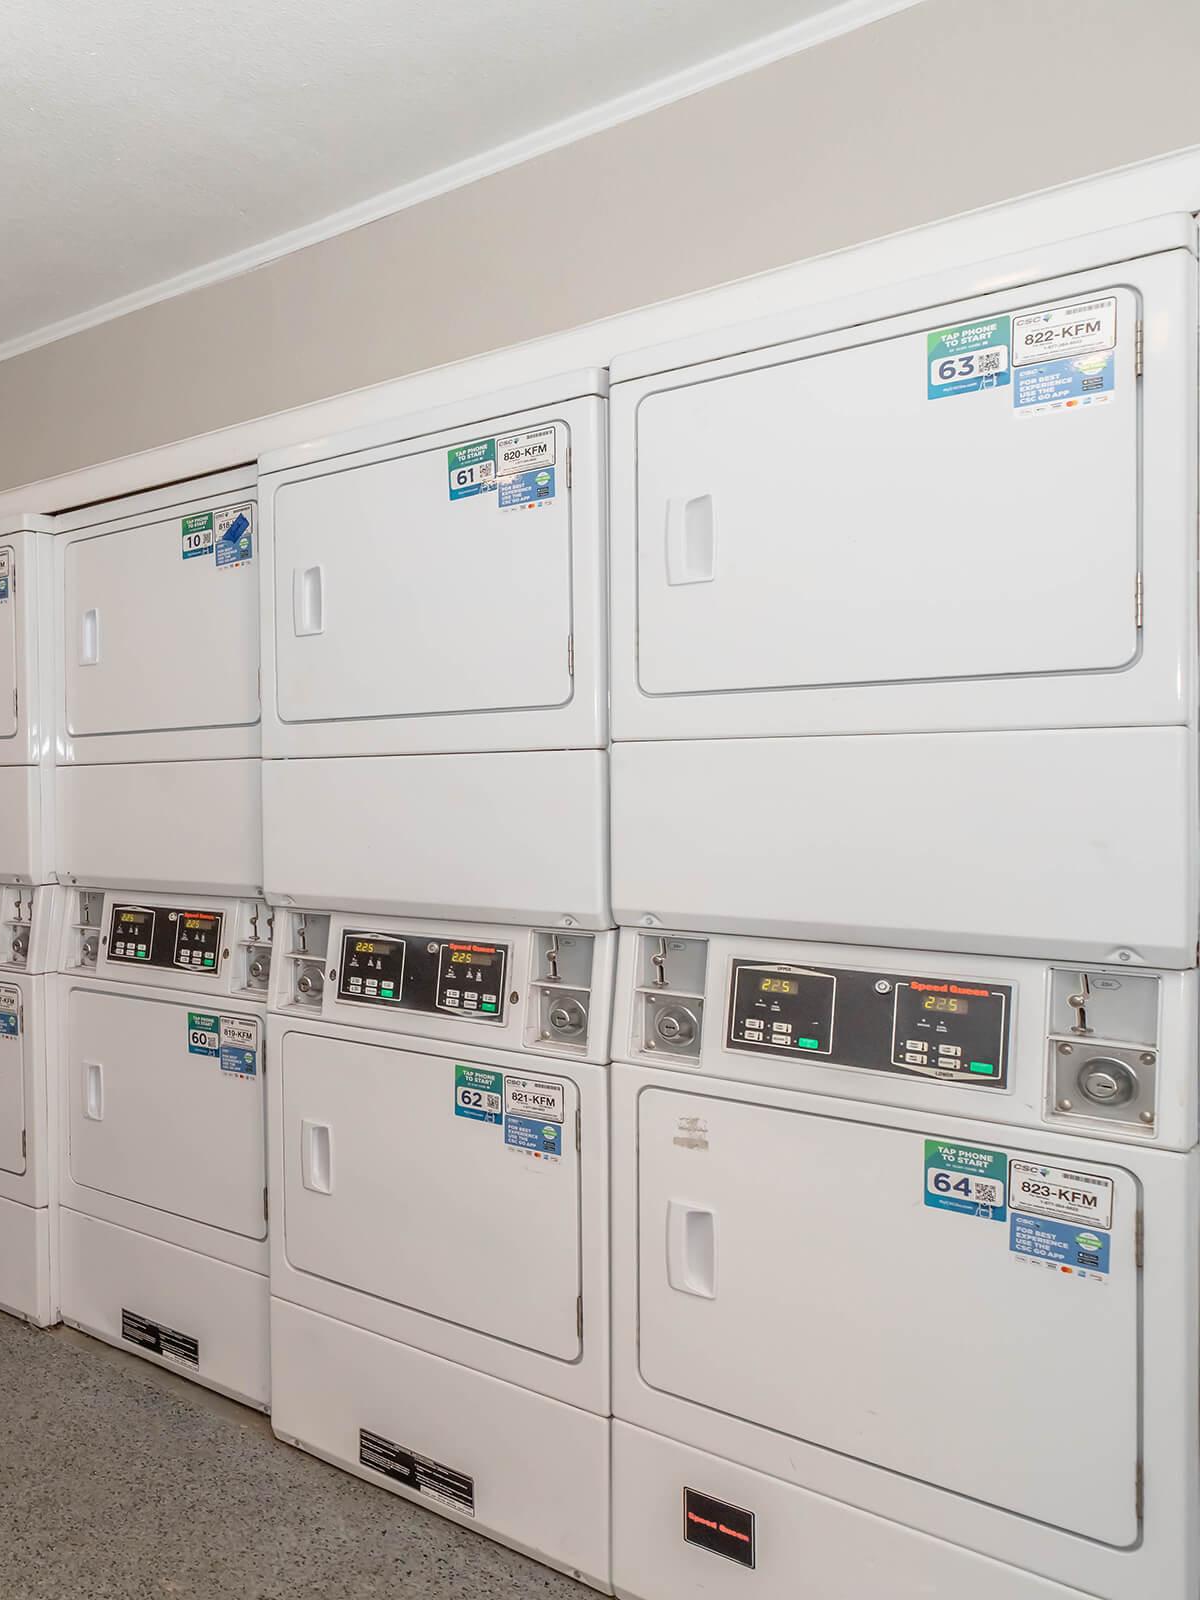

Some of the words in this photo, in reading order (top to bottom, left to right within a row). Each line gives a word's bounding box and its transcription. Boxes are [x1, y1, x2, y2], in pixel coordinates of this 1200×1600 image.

[1016, 316, 1041, 327] CSC
[941, 333, 960, 342] TAP
[962, 323, 997, 337] PHONE
[961, 332, 993, 345] START
[1024, 320, 1101, 346] 822-KFM
[938, 355, 974, 380] 63
[1020, 376, 1073, 391] EXPERIENCE
[1039, 373, 1060, 383] BEST
[1019, 390, 1038, 398] USE
[1052, 390, 1071, 398] APP
[503, 444, 547, 462] 820-KFM
[456, 468, 474, 485] 61
[187, 534, 201, 549] 10
[910, 981, 948, 992] Speed
[949, 985, 990, 997] Queen
[192, 1032, 207, 1045] 60
[461, 1090, 482, 1108] 62
[512, 1092, 556, 1107] 821-KFM
[938, 1146, 957, 1154] TAP
[958, 1150, 993, 1163] PHONE
[942, 1154, 955, 1162] TO
[957, 1157, 989, 1168] START
[1013, 1163, 1040, 1174] CSC
[934, 1172, 972, 1197] 64
[1021, 1181, 1097, 1208] 823-KFM
[1015, 1217, 1034, 1226] CSC
[1016, 1226, 1034, 1235] FOR
[1035, 1230, 1057, 1241] BEST
[1016, 1232, 1069, 1249] EXPERIENCE
[1015, 1238, 1033, 1246] USE
[1034, 1242, 1051, 1251] THE
[1015, 1244, 1033, 1253] CSC
[1033, 1248, 1047, 1256] GO
[1047, 1251, 1065, 1260] APP
[688, 1511, 718, 1530] Speed
[719, 1523, 750, 1543] Queen
